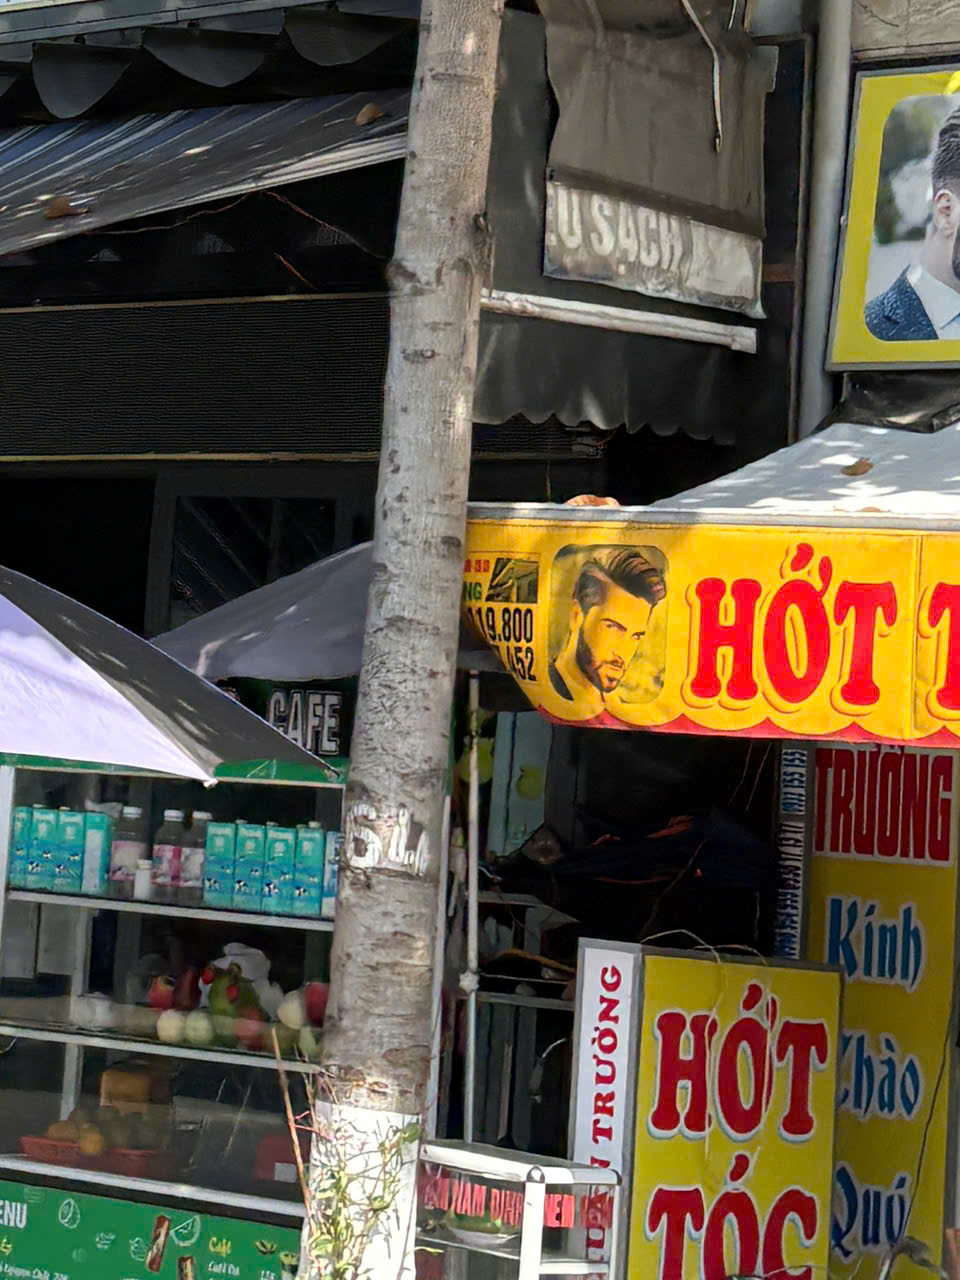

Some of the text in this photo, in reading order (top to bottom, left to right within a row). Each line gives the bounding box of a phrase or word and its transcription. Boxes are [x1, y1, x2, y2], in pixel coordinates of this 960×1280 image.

[692, 542, 899, 707] HỚT
[827, 897, 923, 988] Kính
[590, 964, 623, 1145] TRƯỜNG
[648, 982, 829, 1137] HỚT
[838, 1035, 921, 1118] hào
[646, 1153, 819, 1280] TÓC
